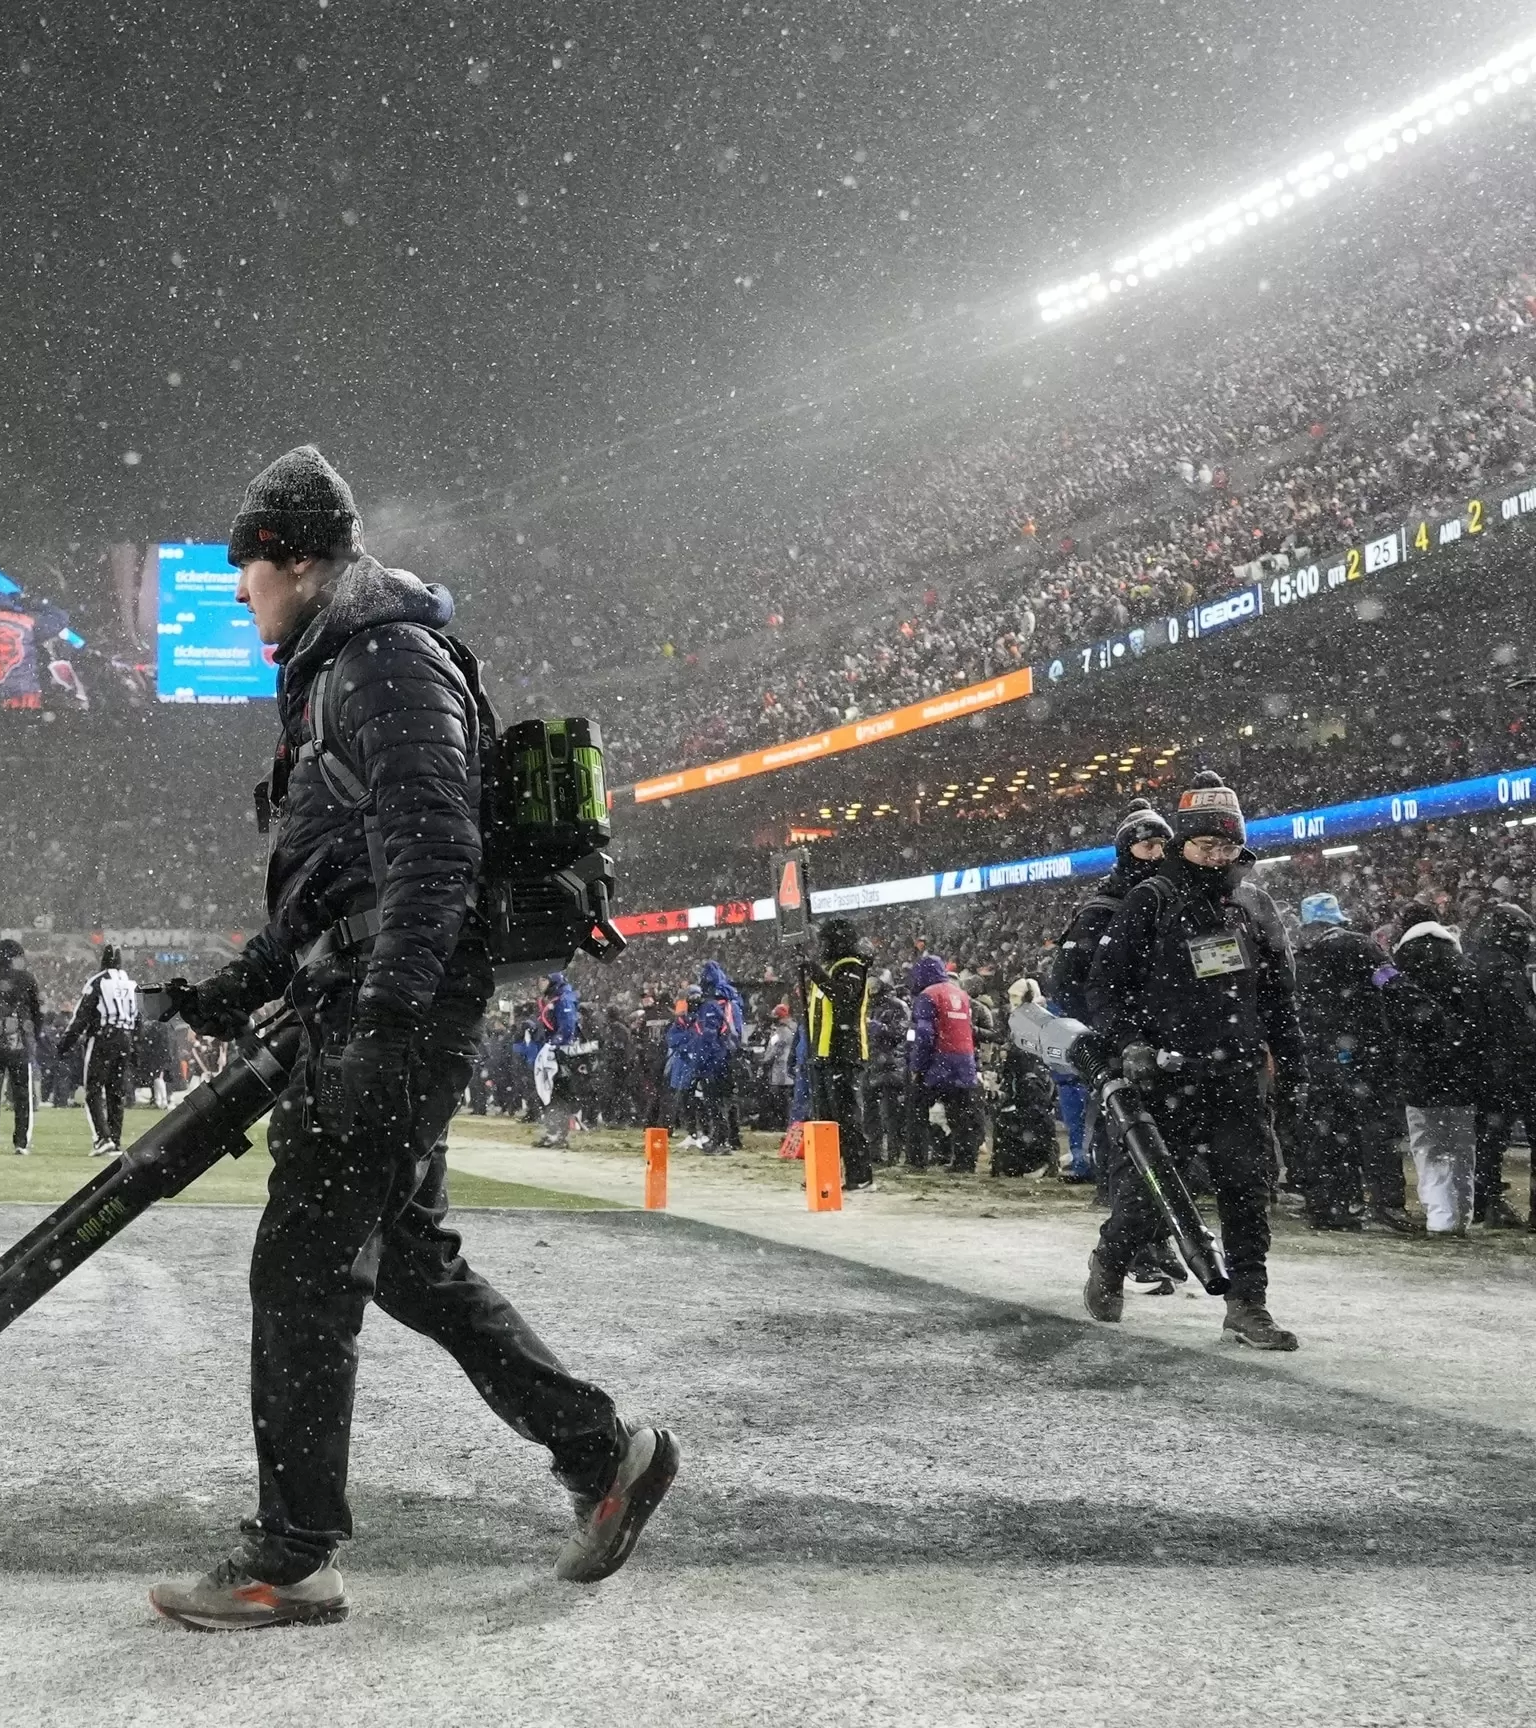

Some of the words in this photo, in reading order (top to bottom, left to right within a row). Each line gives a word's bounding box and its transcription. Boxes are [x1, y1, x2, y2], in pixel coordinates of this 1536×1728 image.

[1415, 521, 1430, 552] 4
[1439, 519, 1461, 545] AND
[1468, 500, 1483, 534] 2
[1502, 496, 1518, 520] ON
[1373, 541, 1391, 567] 25
[175, 570, 241, 583] ticketmast
[1271, 564, 1319, 607] 15:00
[1328, 564, 1346, 589] QTR
[1347, 549, 1362, 581] 2
[1199, 592, 1255, 630] GEICO
[1168, 617, 1179, 644] 0
[174, 645, 250, 658] ticketmaster
[1082, 648, 1092, 673] 7
[1193, 791, 1236, 806] BEAR
[1498, 777, 1509, 803] 0
[1512, 777, 1531, 801] INT
[1392, 798, 1401, 822] 0
[1403, 799, 1418, 820] TD
[1293, 816, 1306, 839] 10
[1307, 816, 1325, 837] ATT
[989, 865, 1028, 887] MATTHEW
[1029, 857, 1071, 881] STAFFORD
[779, 861, 801, 910] 4
[834, 891, 859, 910] Passing
[862, 889, 879, 906] Stats
[104, 929, 189, 946] DOWN
